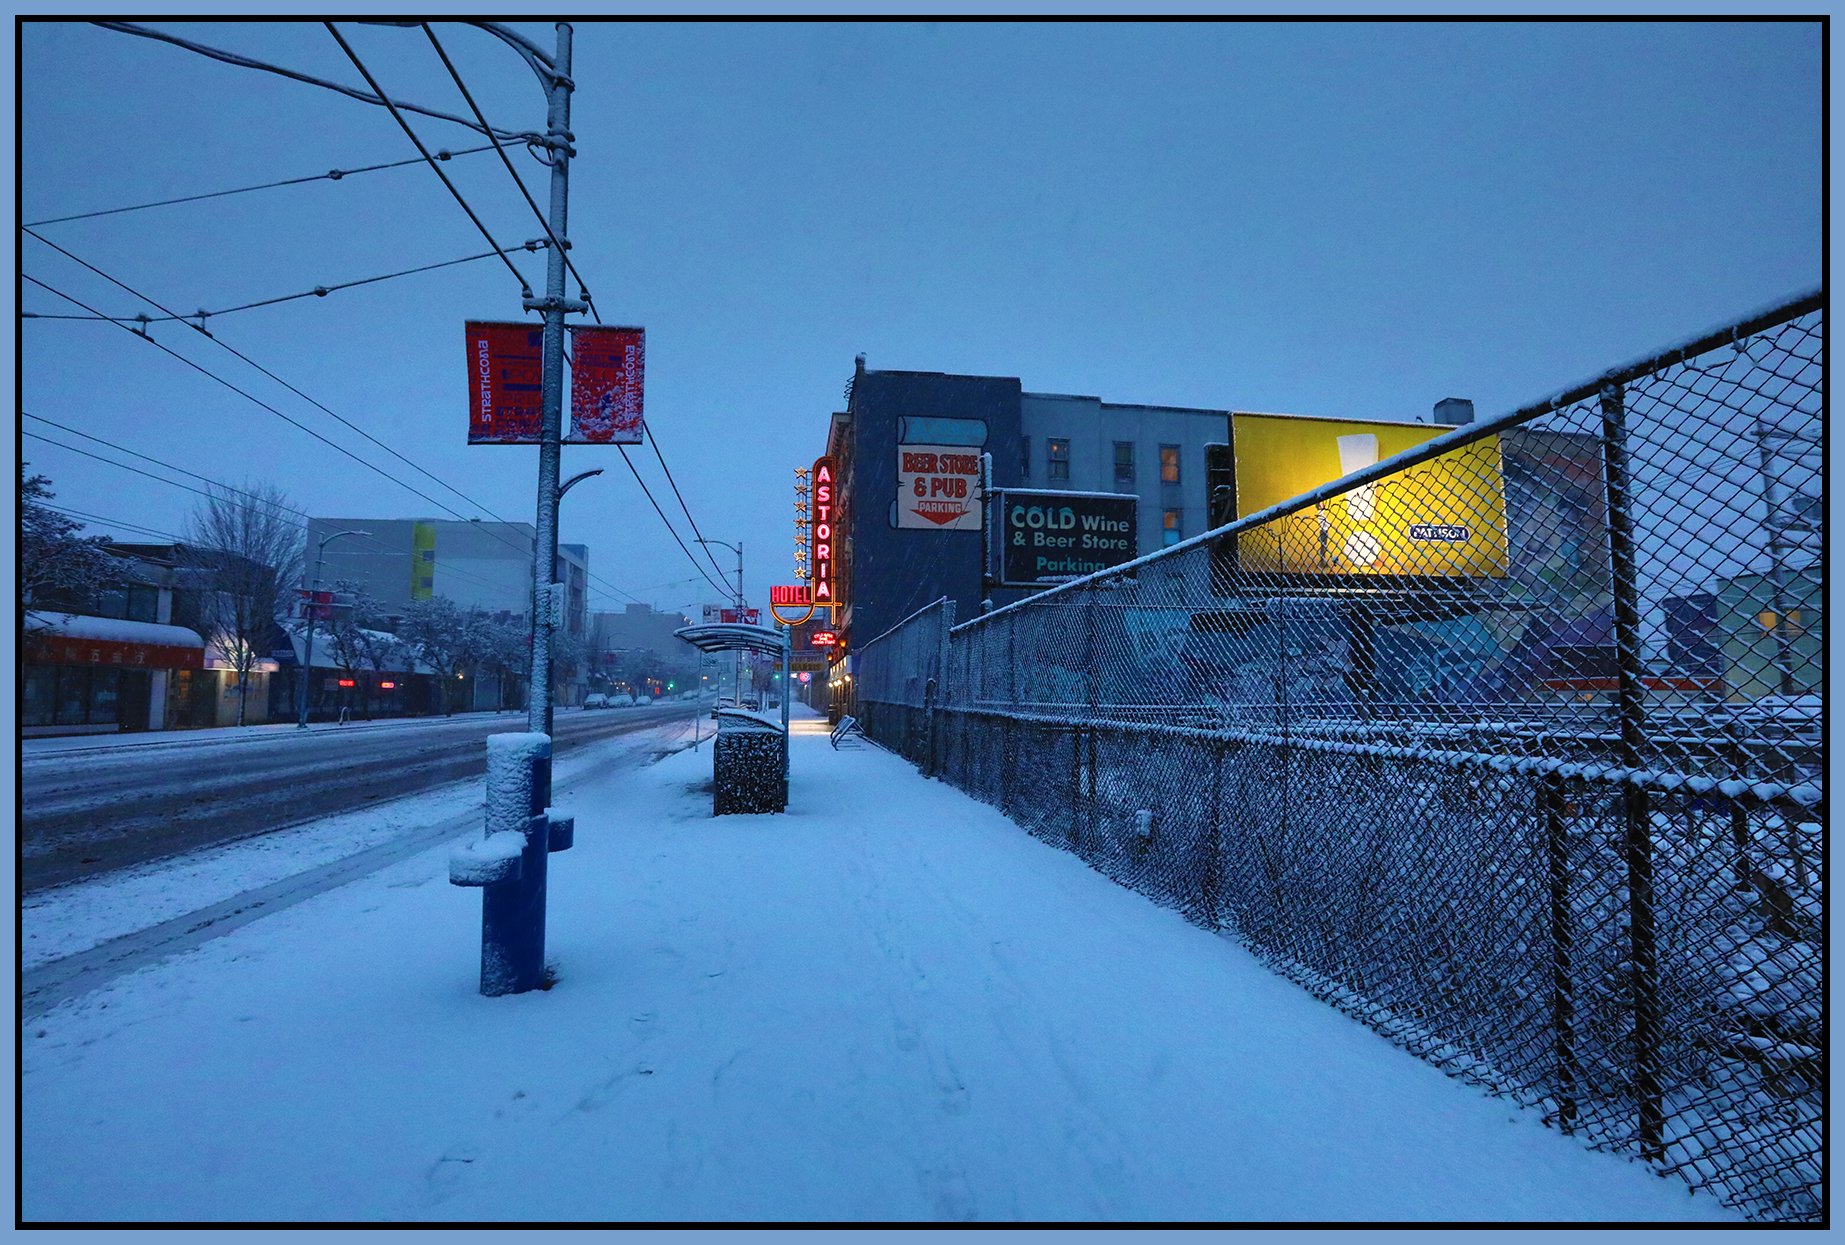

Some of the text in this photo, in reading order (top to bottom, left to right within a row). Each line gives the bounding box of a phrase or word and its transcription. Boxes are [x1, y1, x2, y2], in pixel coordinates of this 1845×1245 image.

[902, 452, 978, 475] BEER STORE
[914, 477, 967, 498] & PUB
[919, 502, 961, 513] PARKING
[1011, 505, 1130, 532] COLD Wine
[817, 465, 831, 597] ASTORIA
[1013, 531, 1128, 550] & Beer Store
[771, 585, 810, 603] HOTEL
